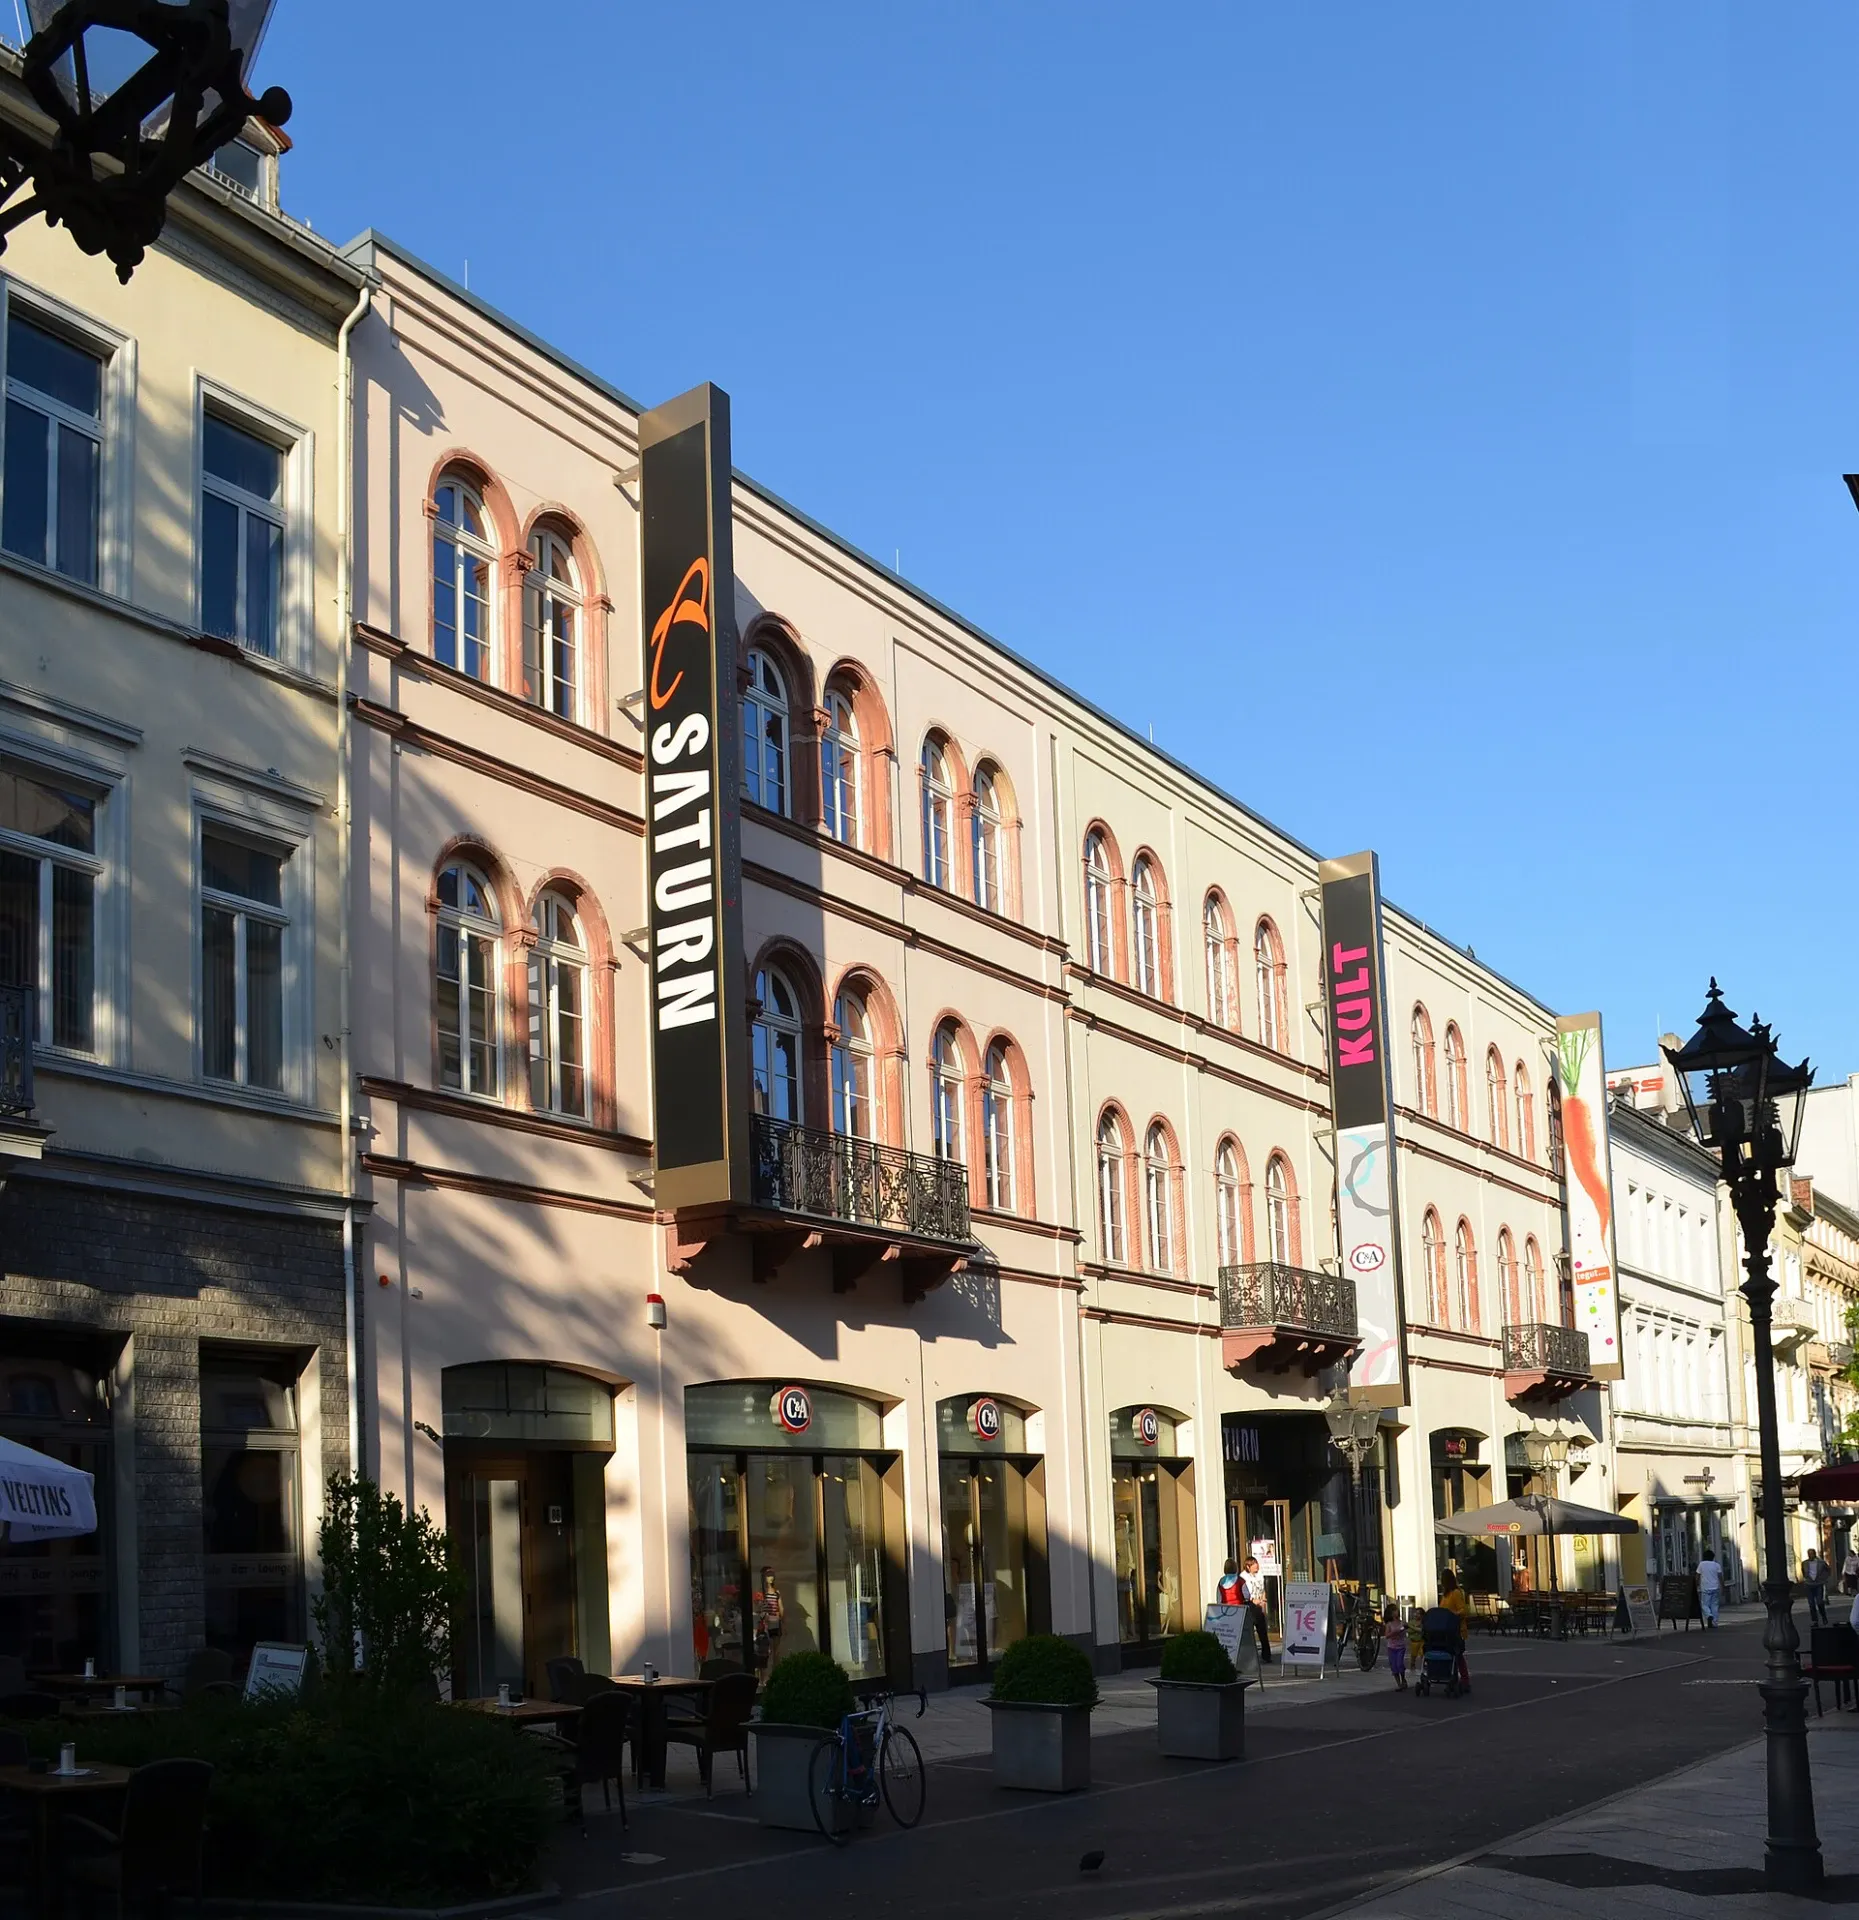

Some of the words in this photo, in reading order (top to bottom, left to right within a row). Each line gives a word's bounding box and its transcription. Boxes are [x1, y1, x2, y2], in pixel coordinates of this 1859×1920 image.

[651, 712, 716, 1032] SATURN
[1333, 942, 1374, 1067] KULT
[1356, 1250, 1380, 1265] C&A
[786, 1396, 809, 1419] C&A
[981, 1409, 998, 1428] C&A
[1144, 1418, 1157, 1435] C&A
[3, 1479, 73, 1517] VELTINS
[1295, 1609, 1317, 1632] 1€
